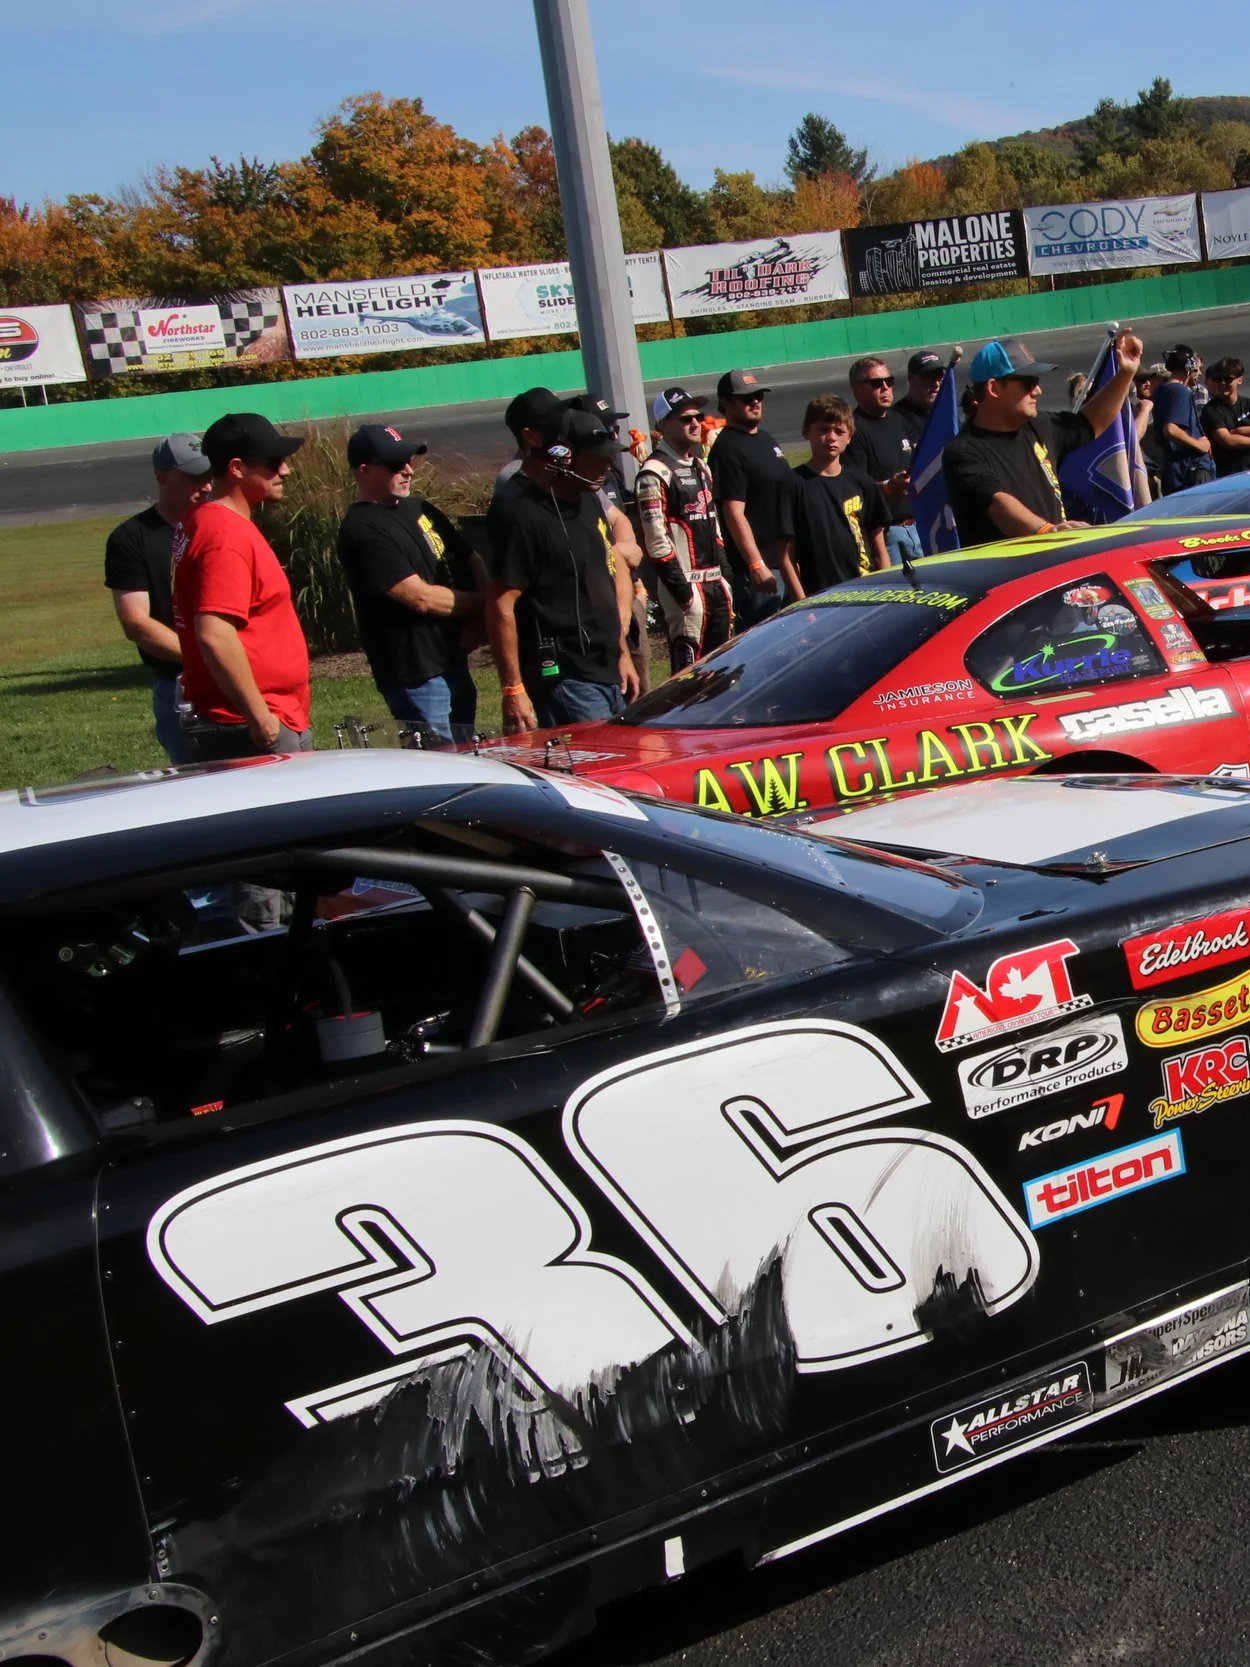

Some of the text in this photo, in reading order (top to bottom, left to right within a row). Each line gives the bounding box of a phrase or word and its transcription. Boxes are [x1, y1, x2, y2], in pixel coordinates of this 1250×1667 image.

[914, 212, 1013, 249] MALONE
[1041, 204, 1146, 241] CODY
[1041, 239, 1141, 256] CHEVROLET
[1213, 232, 1249, 245] NOYLE
[625, 255, 657, 266] RTY TENTS
[920, 239, 1016, 268] PROPERTIES
[482, 270, 517, 281] INFLATABLE
[518, 268, 538, 277] WATER
[539, 267, 560, 276] SLIDES
[757, 260, 812, 277] DARK
[921, 261, 1017, 278] commercial real estate
[922, 277, 953, 287] leasing
[963, 270, 1018, 282] development
[294, 283, 427, 305] MANSFIELD
[711, 272, 811, 294] ROOFING
[297, 294, 447, 318] HELIFLIGHT
[538, 296, 576, 308] SLIDE
[690, 305, 727, 315] SHINGLES
[736, 301, 773, 310] STANDING
[775, 298, 796, 306] SEAM
[148, 313, 216, 337] Northstar
[300, 323, 400, 341] 802-893-1003
[163, 336, 206, 344] FIREWORKS
[303, 336, 425, 352] www.mansfieldheliflight.com
[30, 372, 56, 380] online!
[1178, 535, 1241, 548] Brooks
[1012, 648, 1132, 682] Kurrle
[872, 679, 974, 706] JAMIESON
[880, 691, 976, 712] INSURANCE
[1059, 686, 1233, 741] casella
[828, 714, 1053, 798] CLARK
[1138, 920, 1249, 976] Edelbrock
[936, 938, 1081, 1046] ACT
[1037, 1008, 1056, 1022] TOUR
[992, 1032, 1100, 1088] DRP
[1165, 1038, 1250, 1103] KRC
[973, 1058, 1124, 1118] Performance Products
[1150, 1095, 1200, 1127] Power
[1018, 1103, 1107, 1152] KONI
[1036, 1147, 1173, 1214] tilton
[146, 1018, 1041, 1429] 36
[966, 1373, 1081, 1432] ALLSTAR
[970, 1391, 1084, 1447] PERFORMANCE
